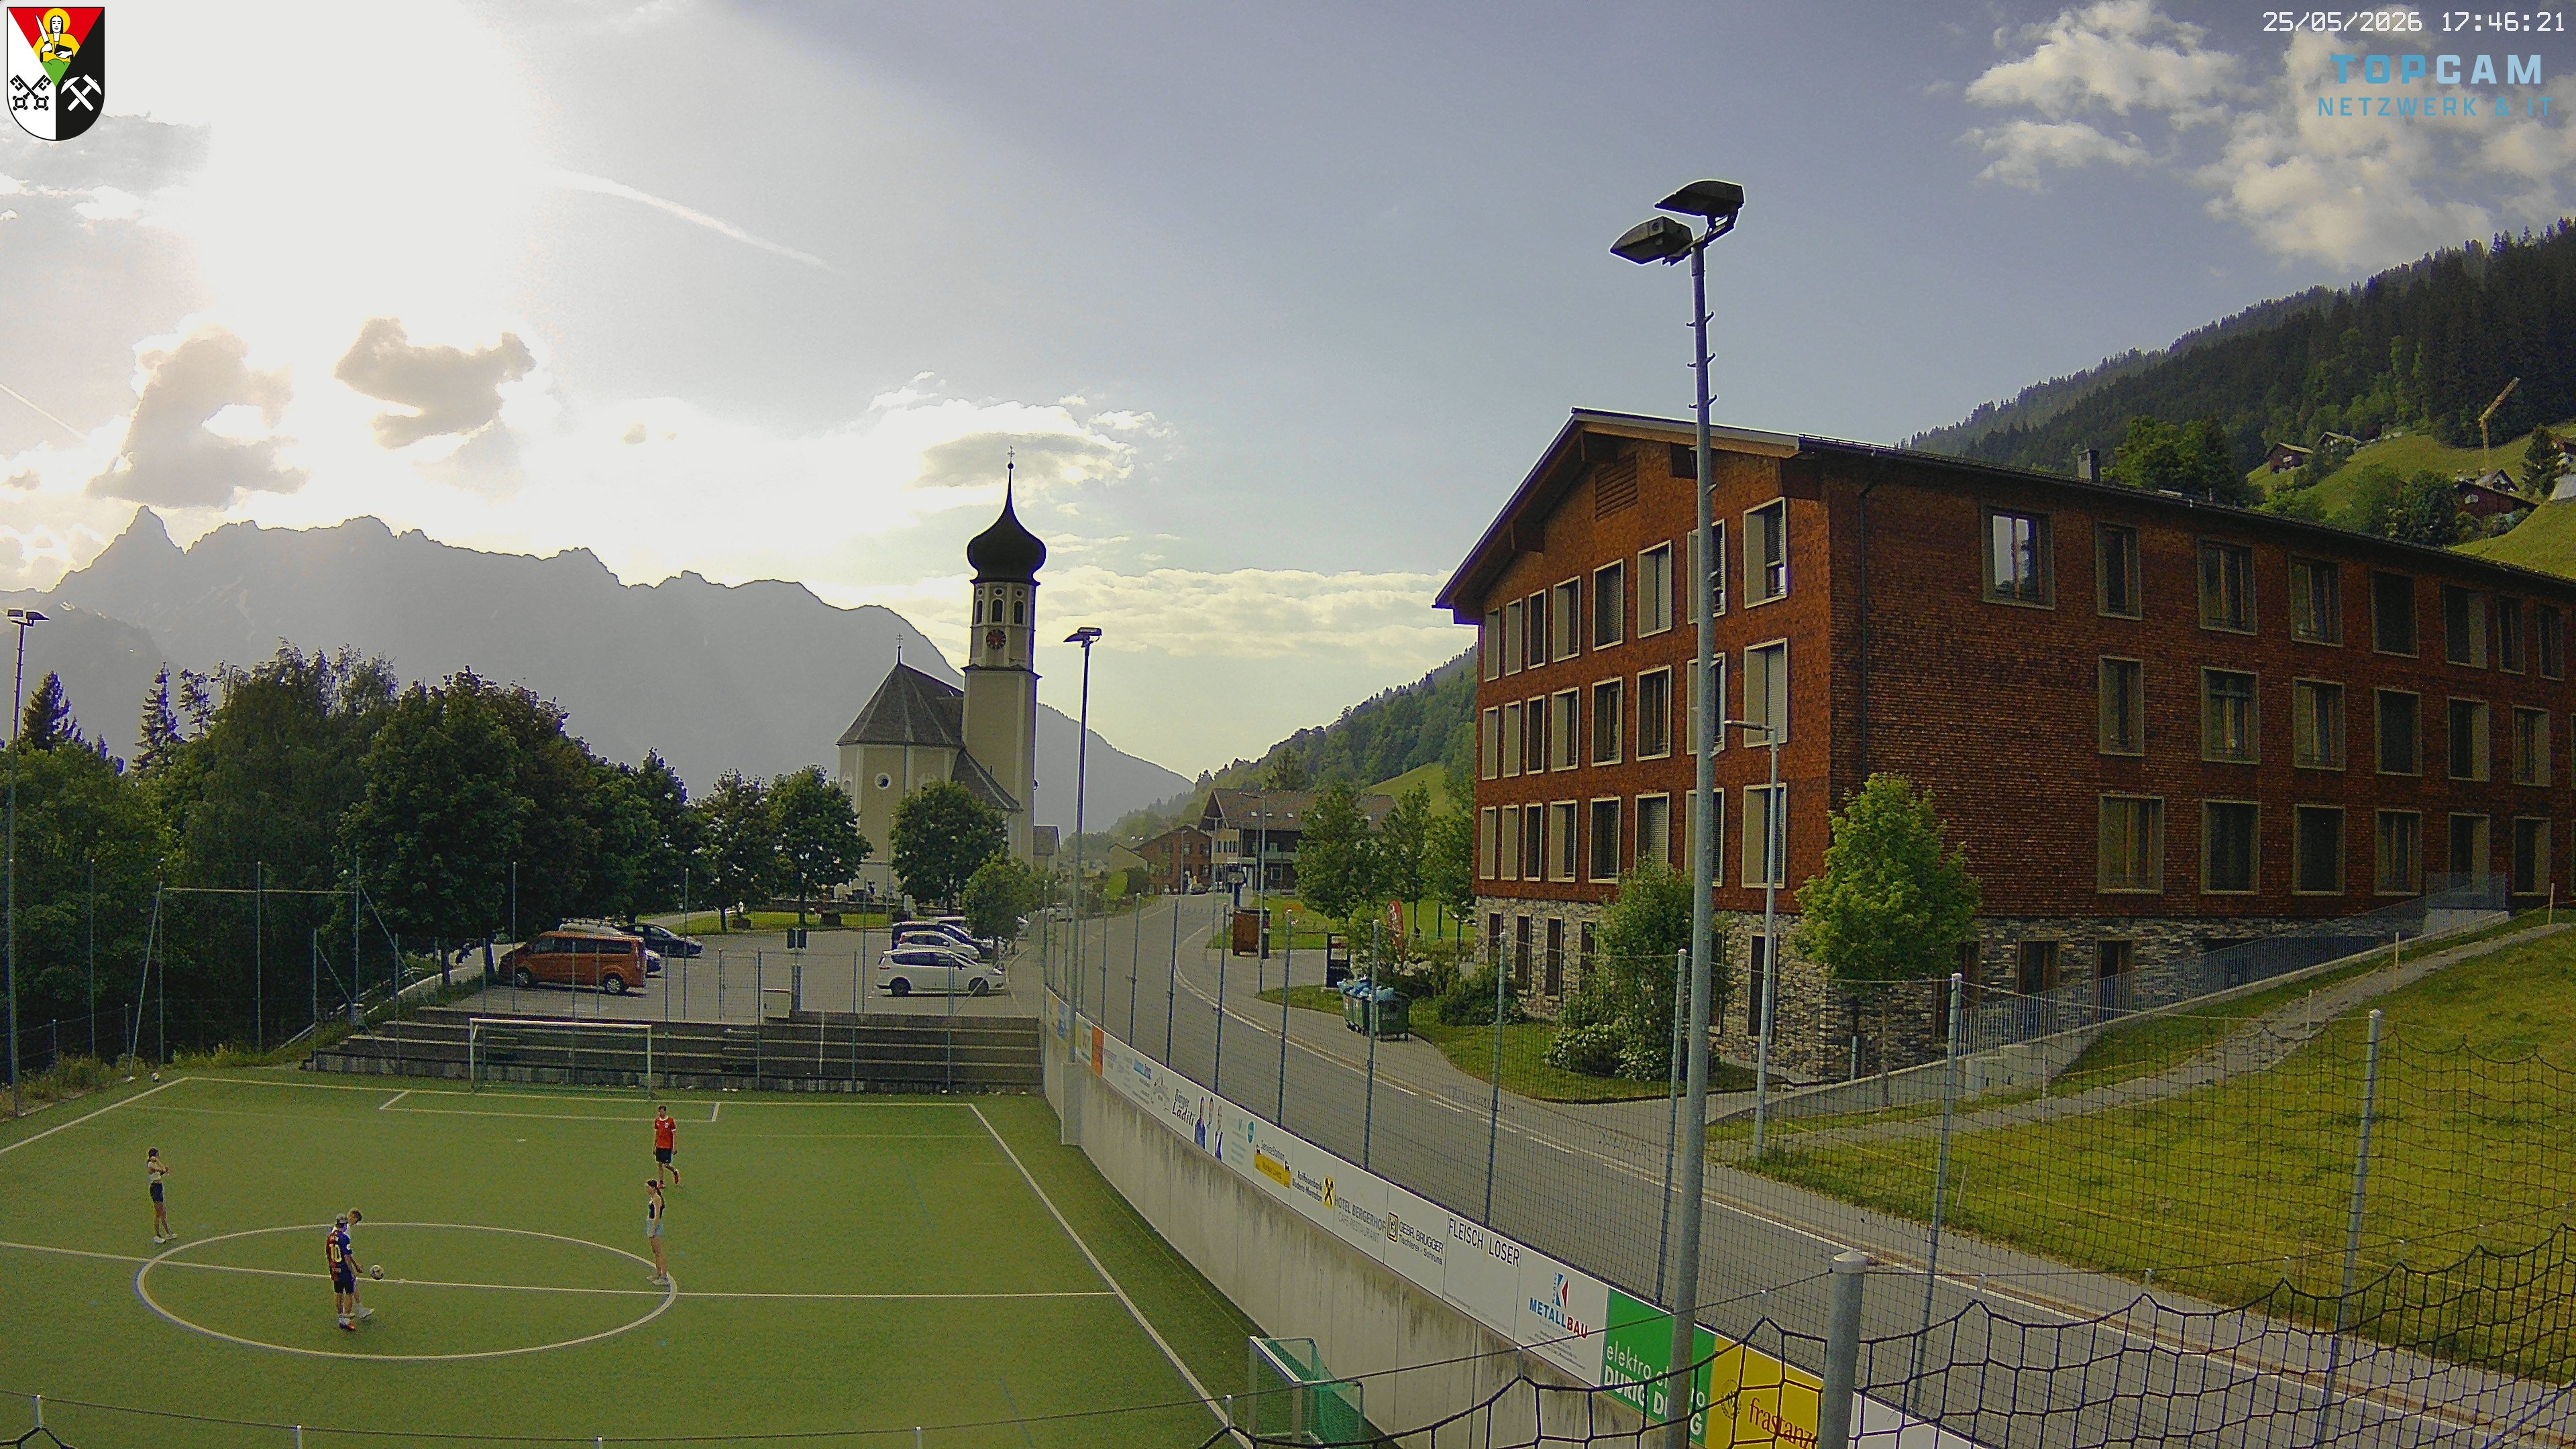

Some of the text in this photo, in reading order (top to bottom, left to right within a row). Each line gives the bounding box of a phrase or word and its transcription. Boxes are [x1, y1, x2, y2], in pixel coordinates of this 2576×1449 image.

[1335, 1195, 1351, 1214] HOTEL
[1352, 1204, 1387, 1232] BERGERHOF
[329, 1243, 342, 1263] 10
[1424, 1248, 1442, 1265] Schruns
[1448, 1218, 1520, 1268] FLEISCH LOSER
[1529, 1297, 1589, 1339] METALLBAU
[1606, 1340, 1652, 1380] elektro
[1750, 1397, 1814, 1449] frastanz
